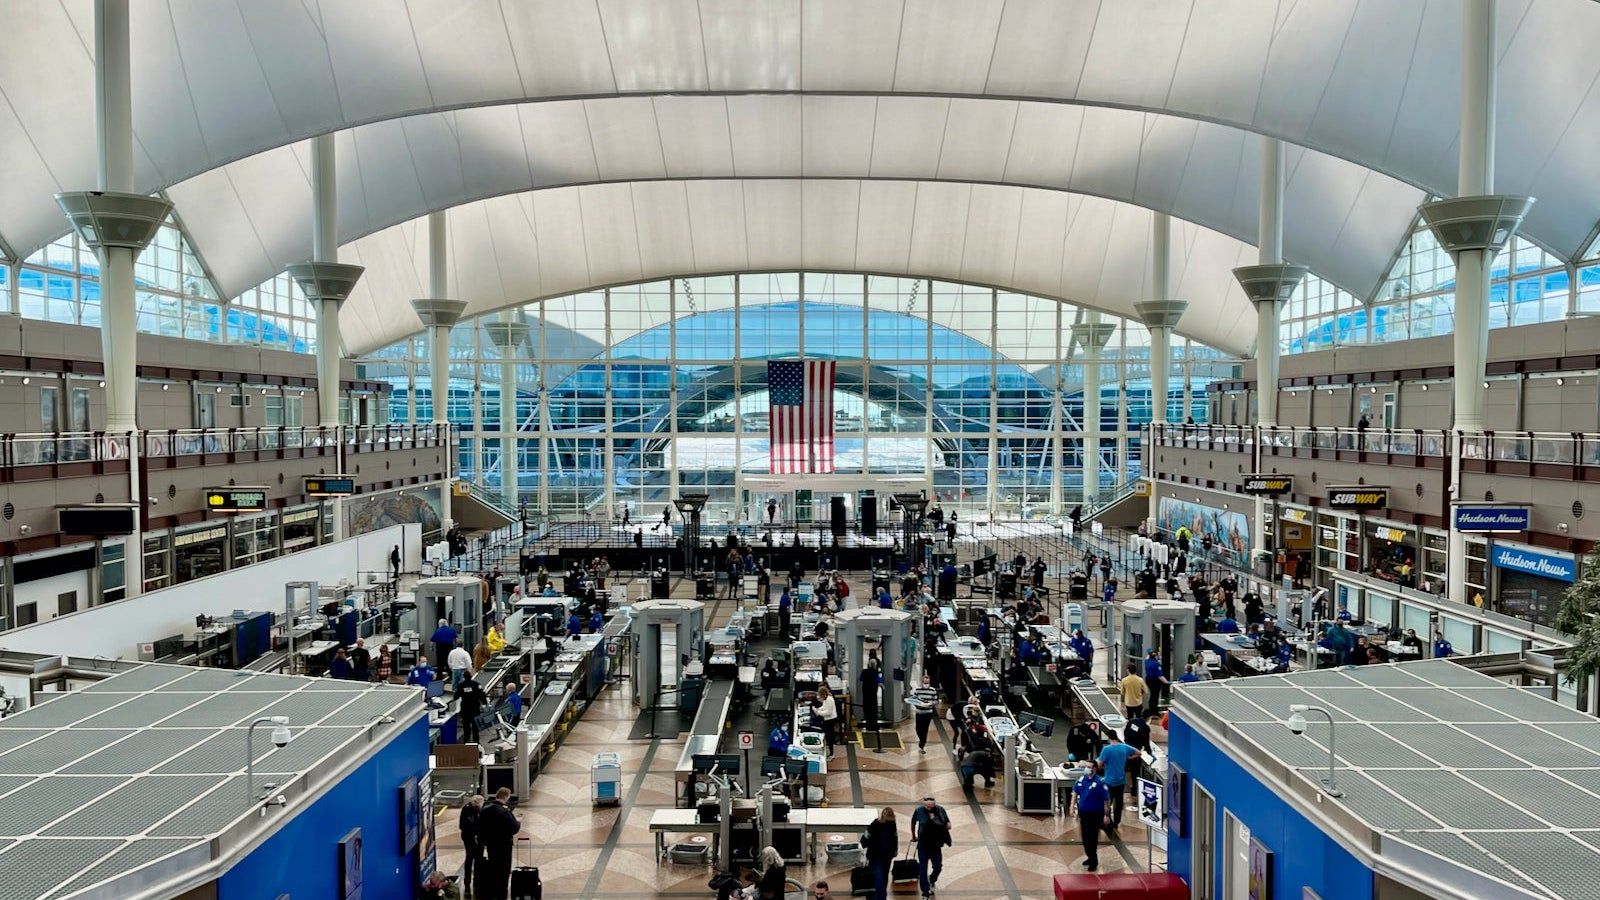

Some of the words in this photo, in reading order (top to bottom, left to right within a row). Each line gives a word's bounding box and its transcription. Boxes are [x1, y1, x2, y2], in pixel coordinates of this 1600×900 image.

[1246, 480, 1290, 490] SUBWAY
[1331, 493, 1385, 504] SUBWAY
[1458, 513, 1496, 523] Hudson
[1496, 513, 1526, 523] News
[1375, 526, 1406, 543] SUBWAY
[1499, 551, 1537, 570] Hudson
[1537, 559, 1570, 577] News
